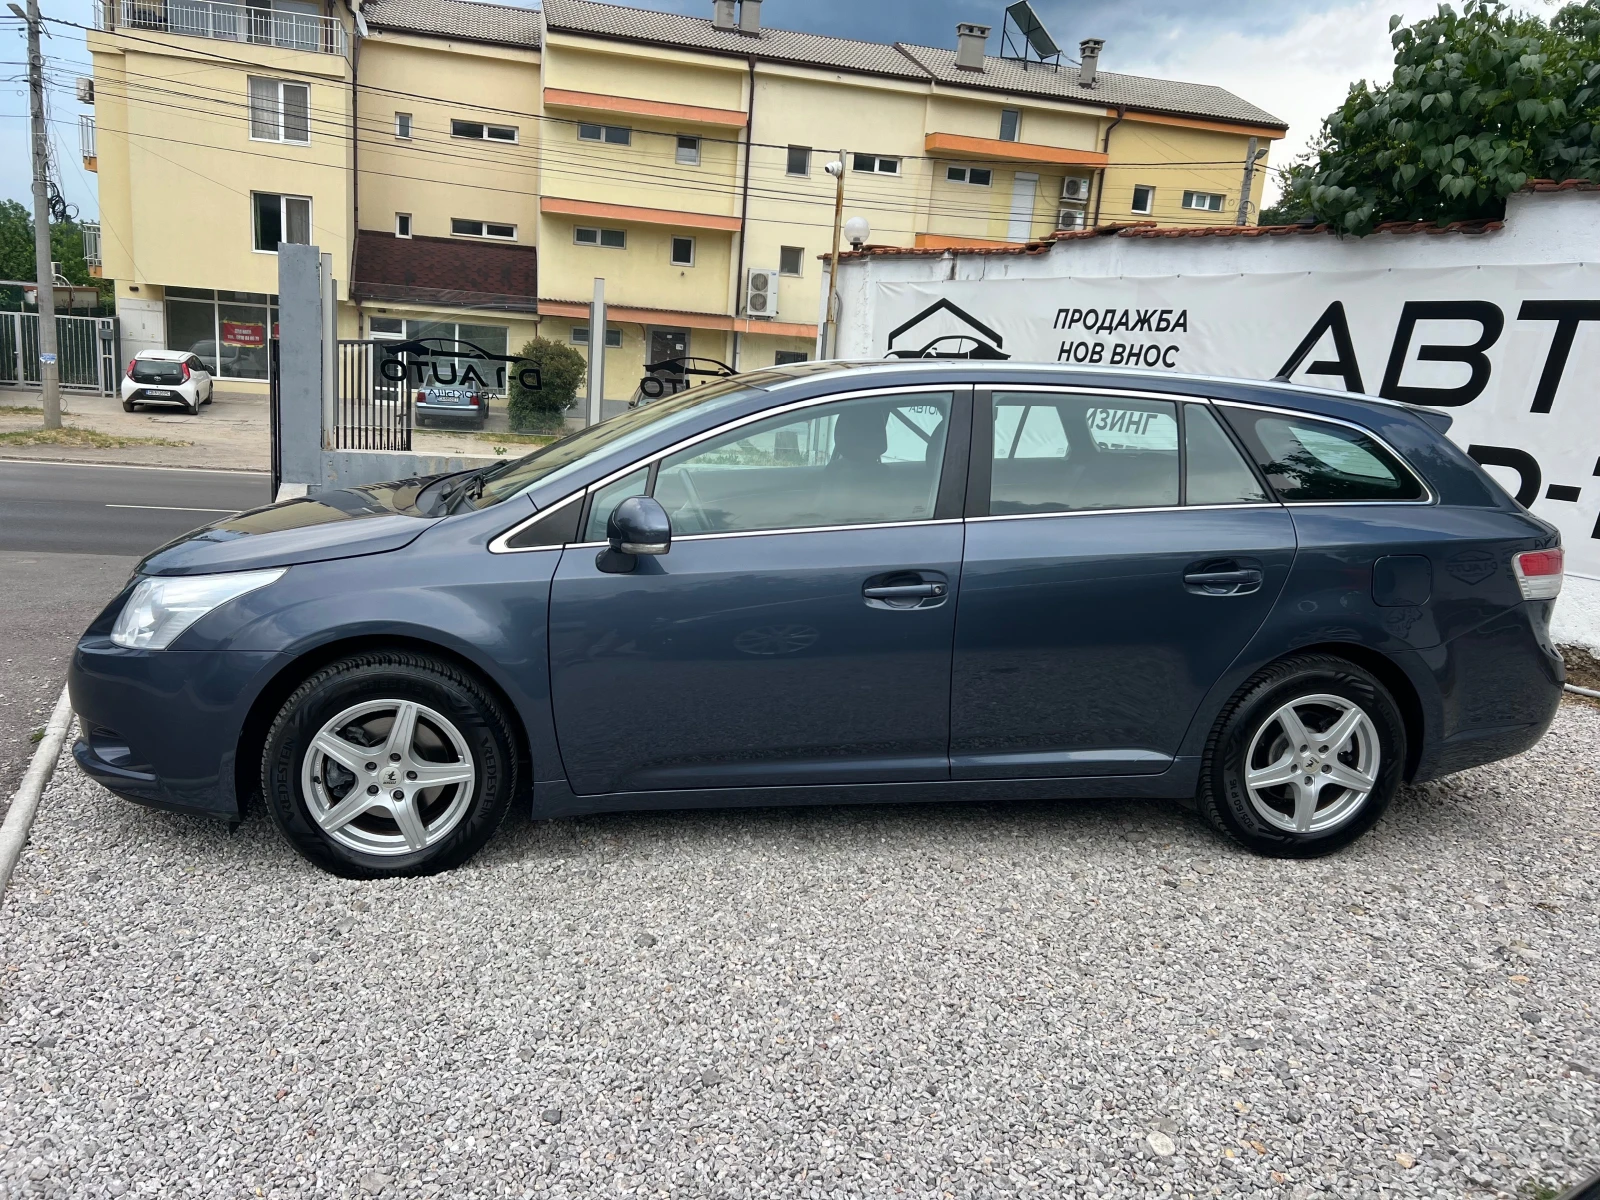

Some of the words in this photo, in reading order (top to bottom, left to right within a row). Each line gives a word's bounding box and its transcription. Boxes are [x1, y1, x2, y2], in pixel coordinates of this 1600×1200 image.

[1053, 308, 1188, 335] ПРОДАЖБА
[1057, 341, 1105, 363] НОВ
[1110, 343, 1180, 368] ВНОС
[276, 736, 296, 823] VREDESTEIN
[477, 735, 498, 820] VREDESTEIN
